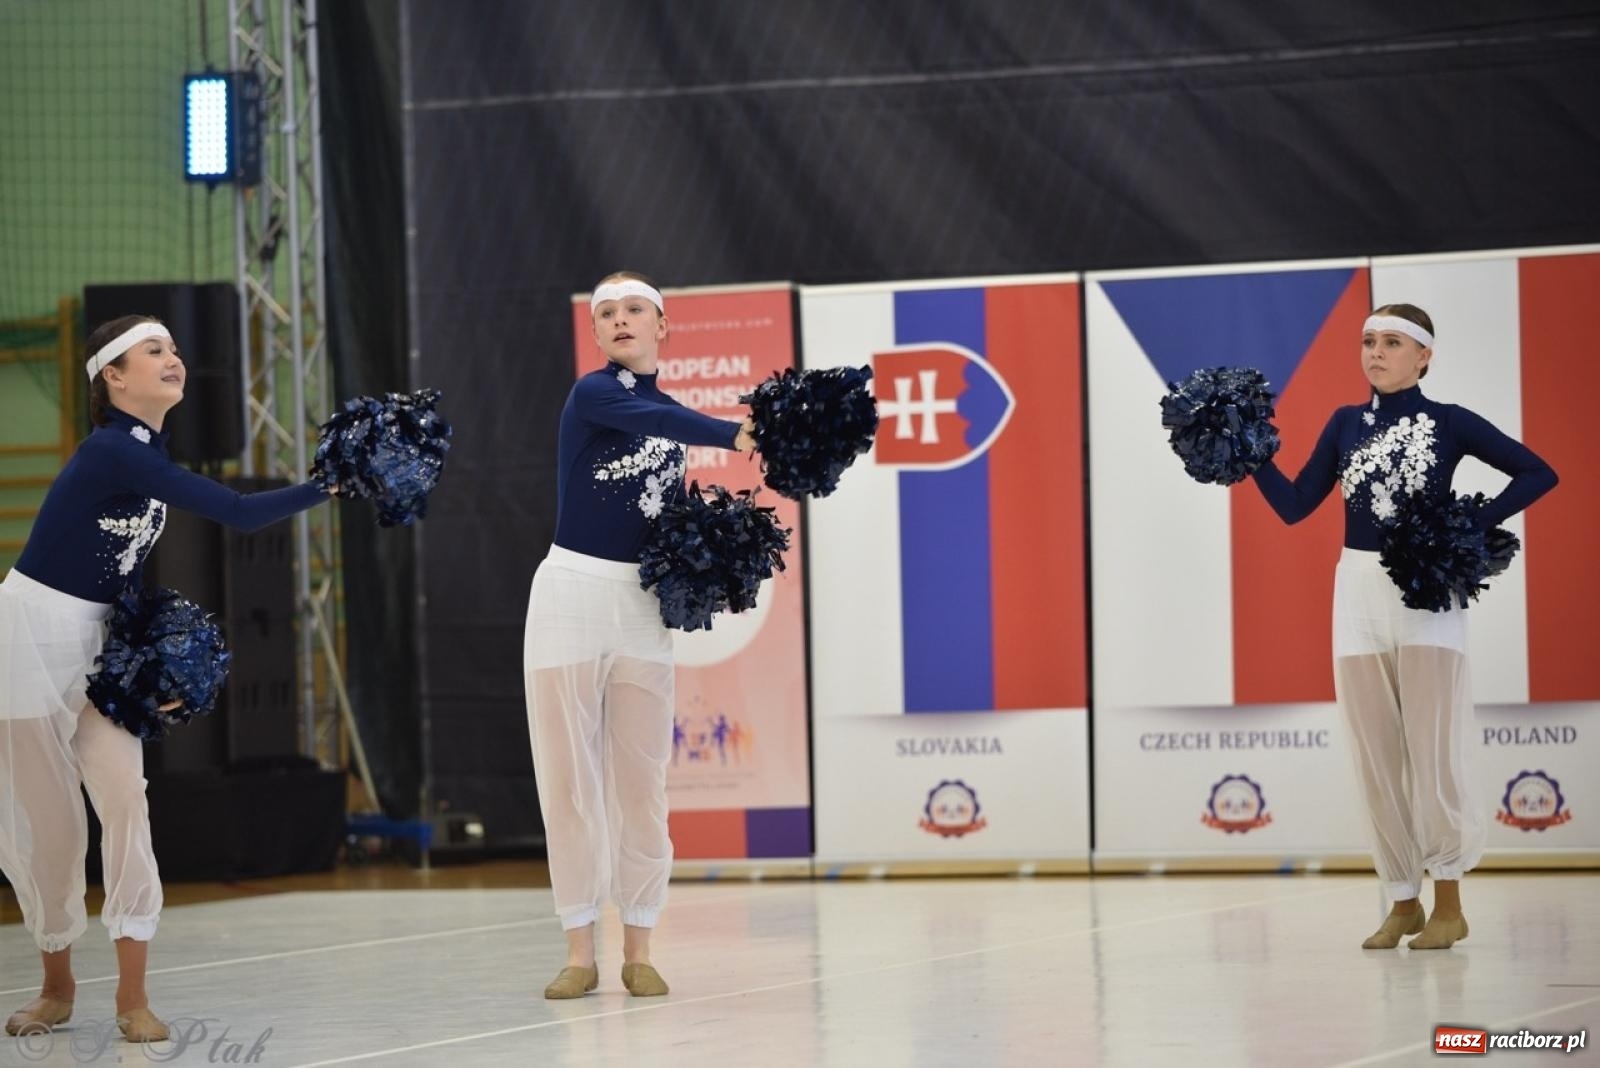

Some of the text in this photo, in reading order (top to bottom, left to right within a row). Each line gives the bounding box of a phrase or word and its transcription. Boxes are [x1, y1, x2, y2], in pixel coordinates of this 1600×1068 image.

[656, 355, 750, 380] ROPEAN
[687, 446, 727, 469] ORT
[896, 737, 1003, 756] SLOVAKIA
[1139, 729, 1329, 751] CZECH REPUBLIC
[1483, 726, 1577, 745] POLAND
